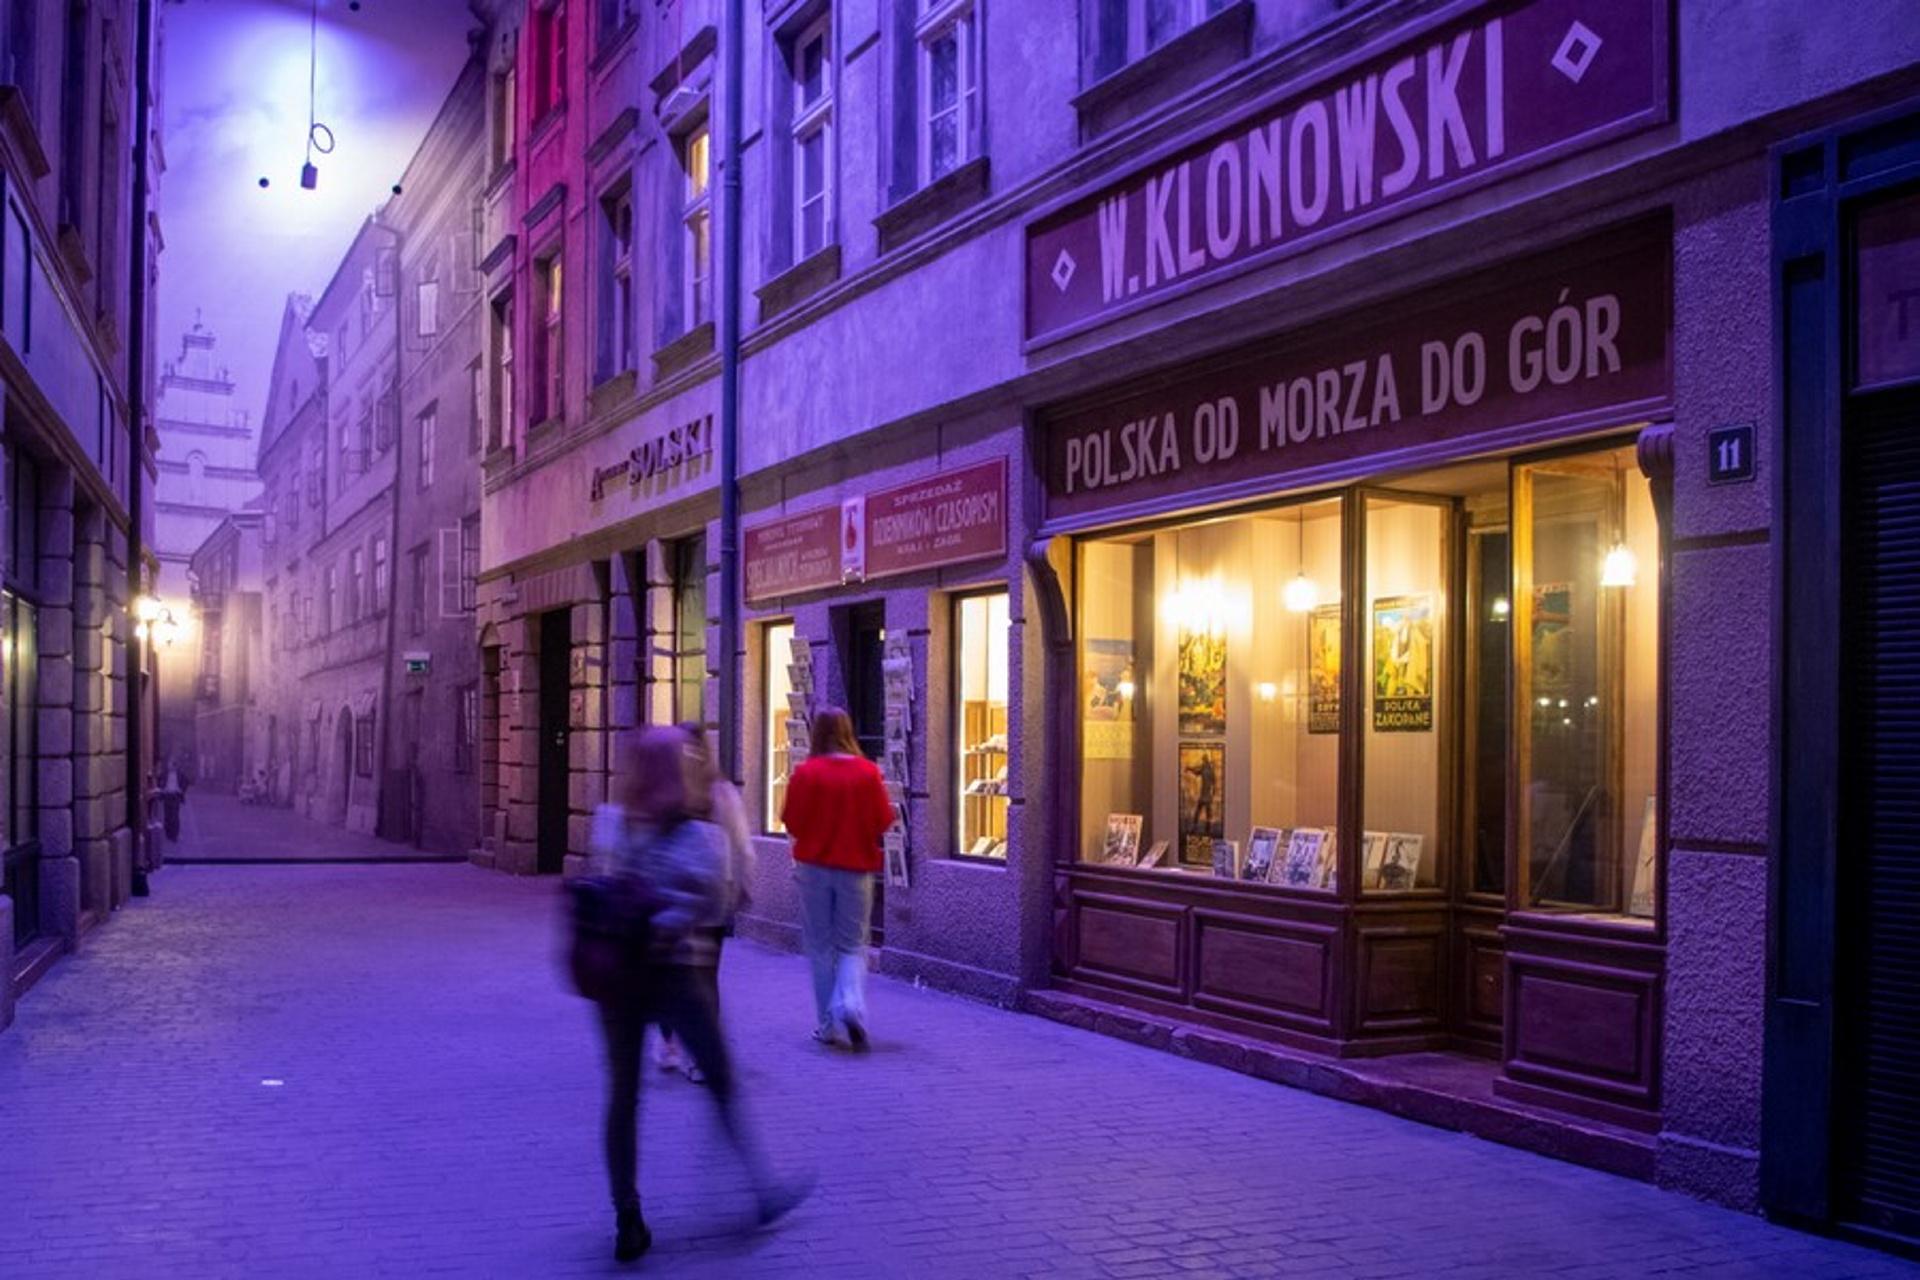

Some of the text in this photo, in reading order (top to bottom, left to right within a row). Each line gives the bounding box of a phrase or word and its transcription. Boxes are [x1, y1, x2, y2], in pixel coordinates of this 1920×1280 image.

[1065, 288, 1622, 494] POLSKA OD MORZA DO GÓR
[1717, 437, 1740, 471] 11
